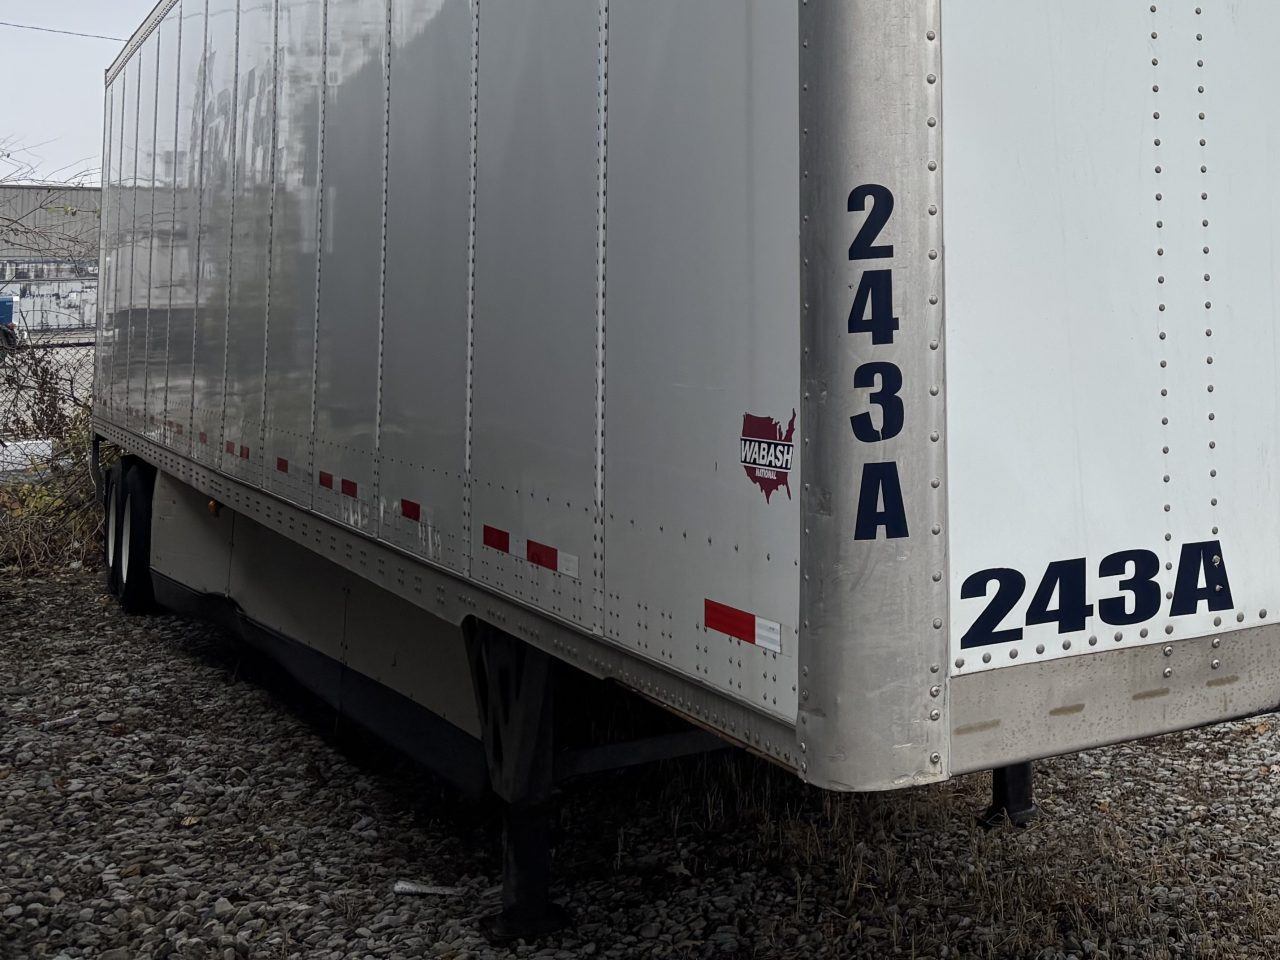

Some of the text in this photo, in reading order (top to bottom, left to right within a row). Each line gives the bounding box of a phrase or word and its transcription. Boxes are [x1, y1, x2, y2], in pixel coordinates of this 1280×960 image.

[847, 183, 909, 541] 243A
[741, 440, 793, 469] WABASH
[755, 468, 777, 480] NATIONAL
[960, 540, 1234, 650] 243A
